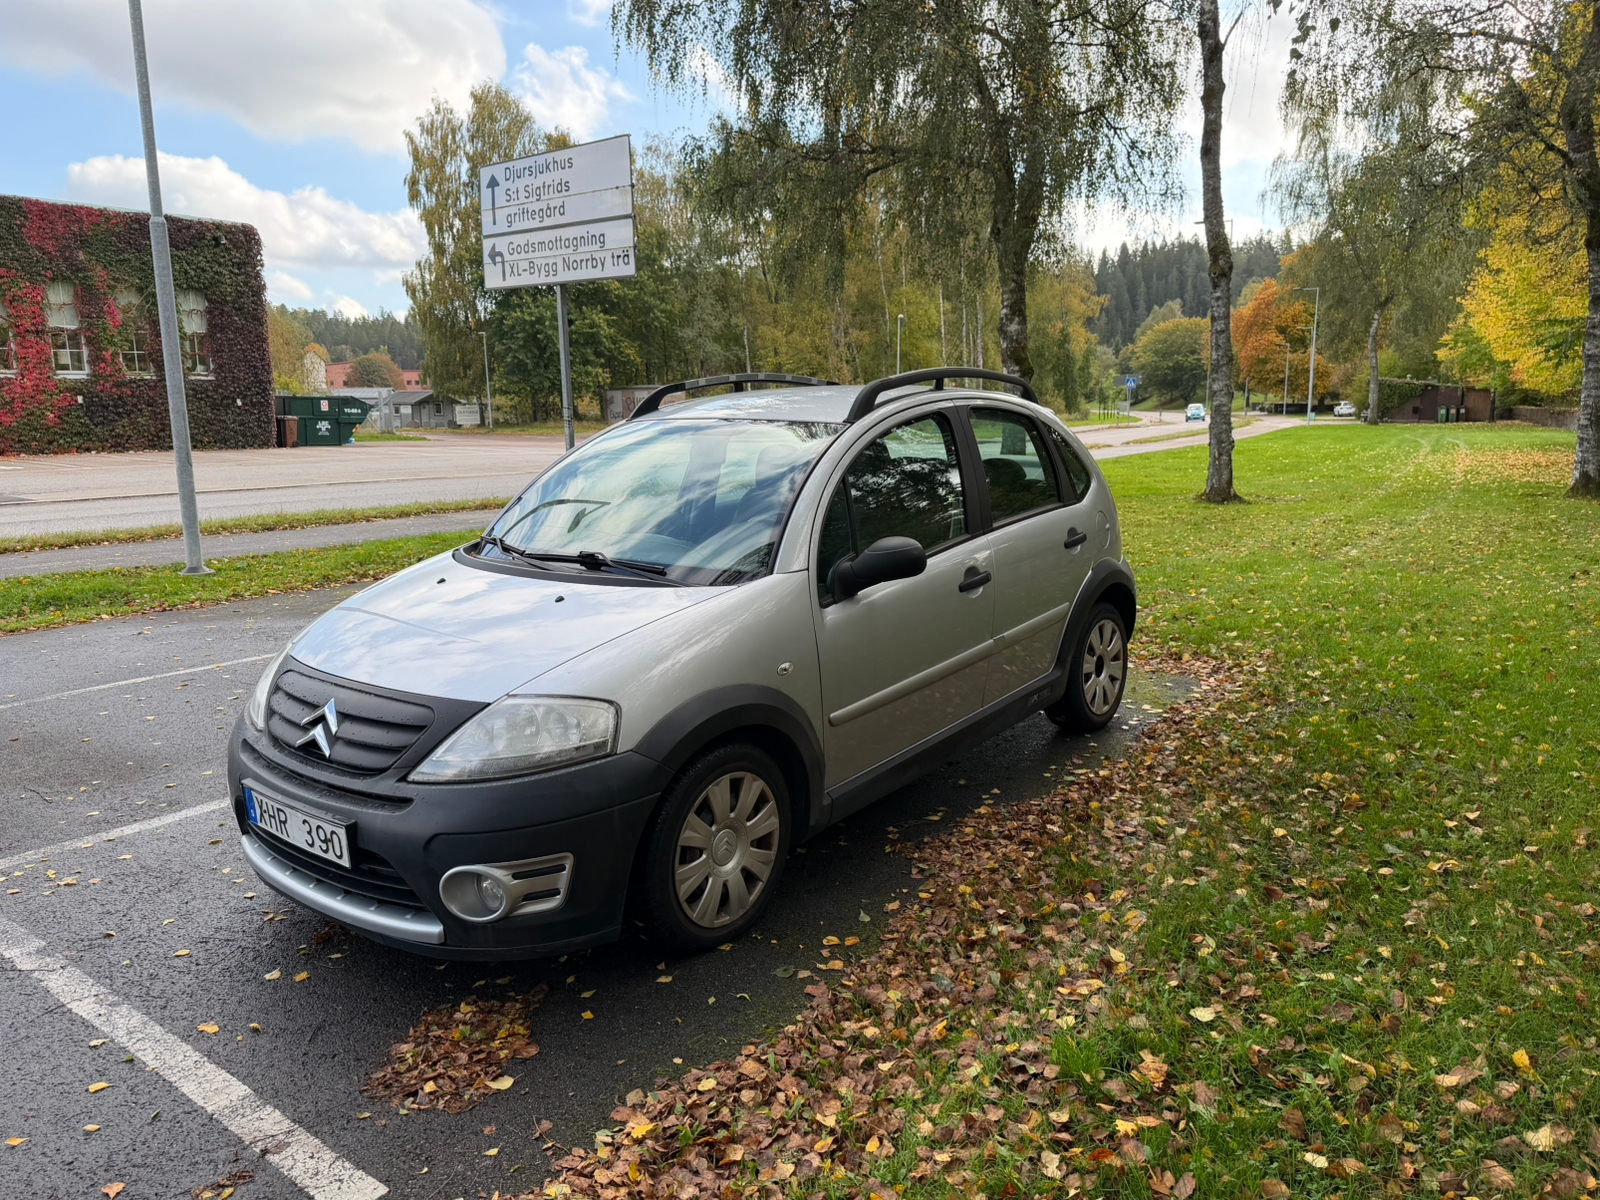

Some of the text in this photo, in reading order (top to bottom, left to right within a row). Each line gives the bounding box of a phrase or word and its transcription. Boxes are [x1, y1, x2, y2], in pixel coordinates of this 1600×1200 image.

[504, 157, 574, 184] Djursjukhus
[504, 178, 571, 203] S:t Sigfrids
[506, 200, 566, 228] griftegård
[507, 231, 606, 256] Godsmottagning
[508, 249, 630, 278] XL-Bygg Norrby trä
[255, 796, 343, 860] XHR 390
